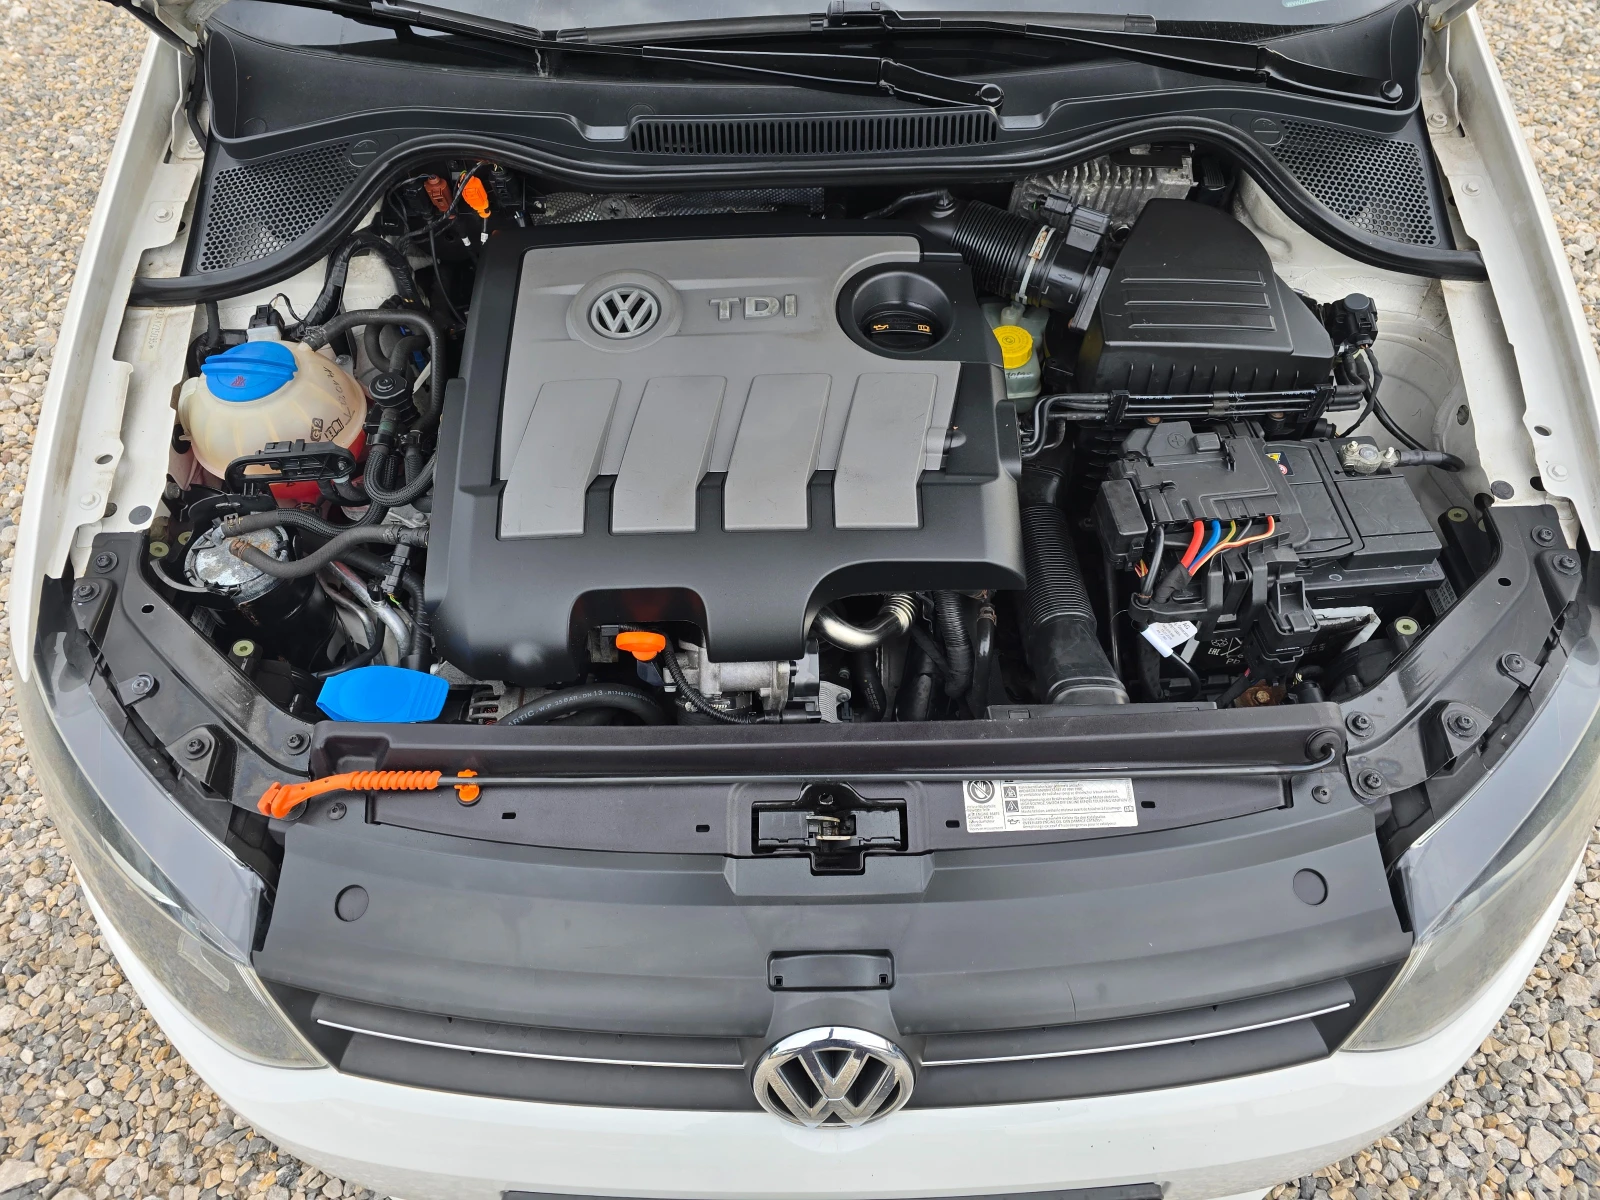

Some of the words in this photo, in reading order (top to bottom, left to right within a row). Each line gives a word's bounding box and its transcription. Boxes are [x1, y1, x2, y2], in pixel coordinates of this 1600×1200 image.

[592, 287, 658, 338] VW
[709, 294, 797, 321] TDI
[756, 1030, 911, 1129] VW
